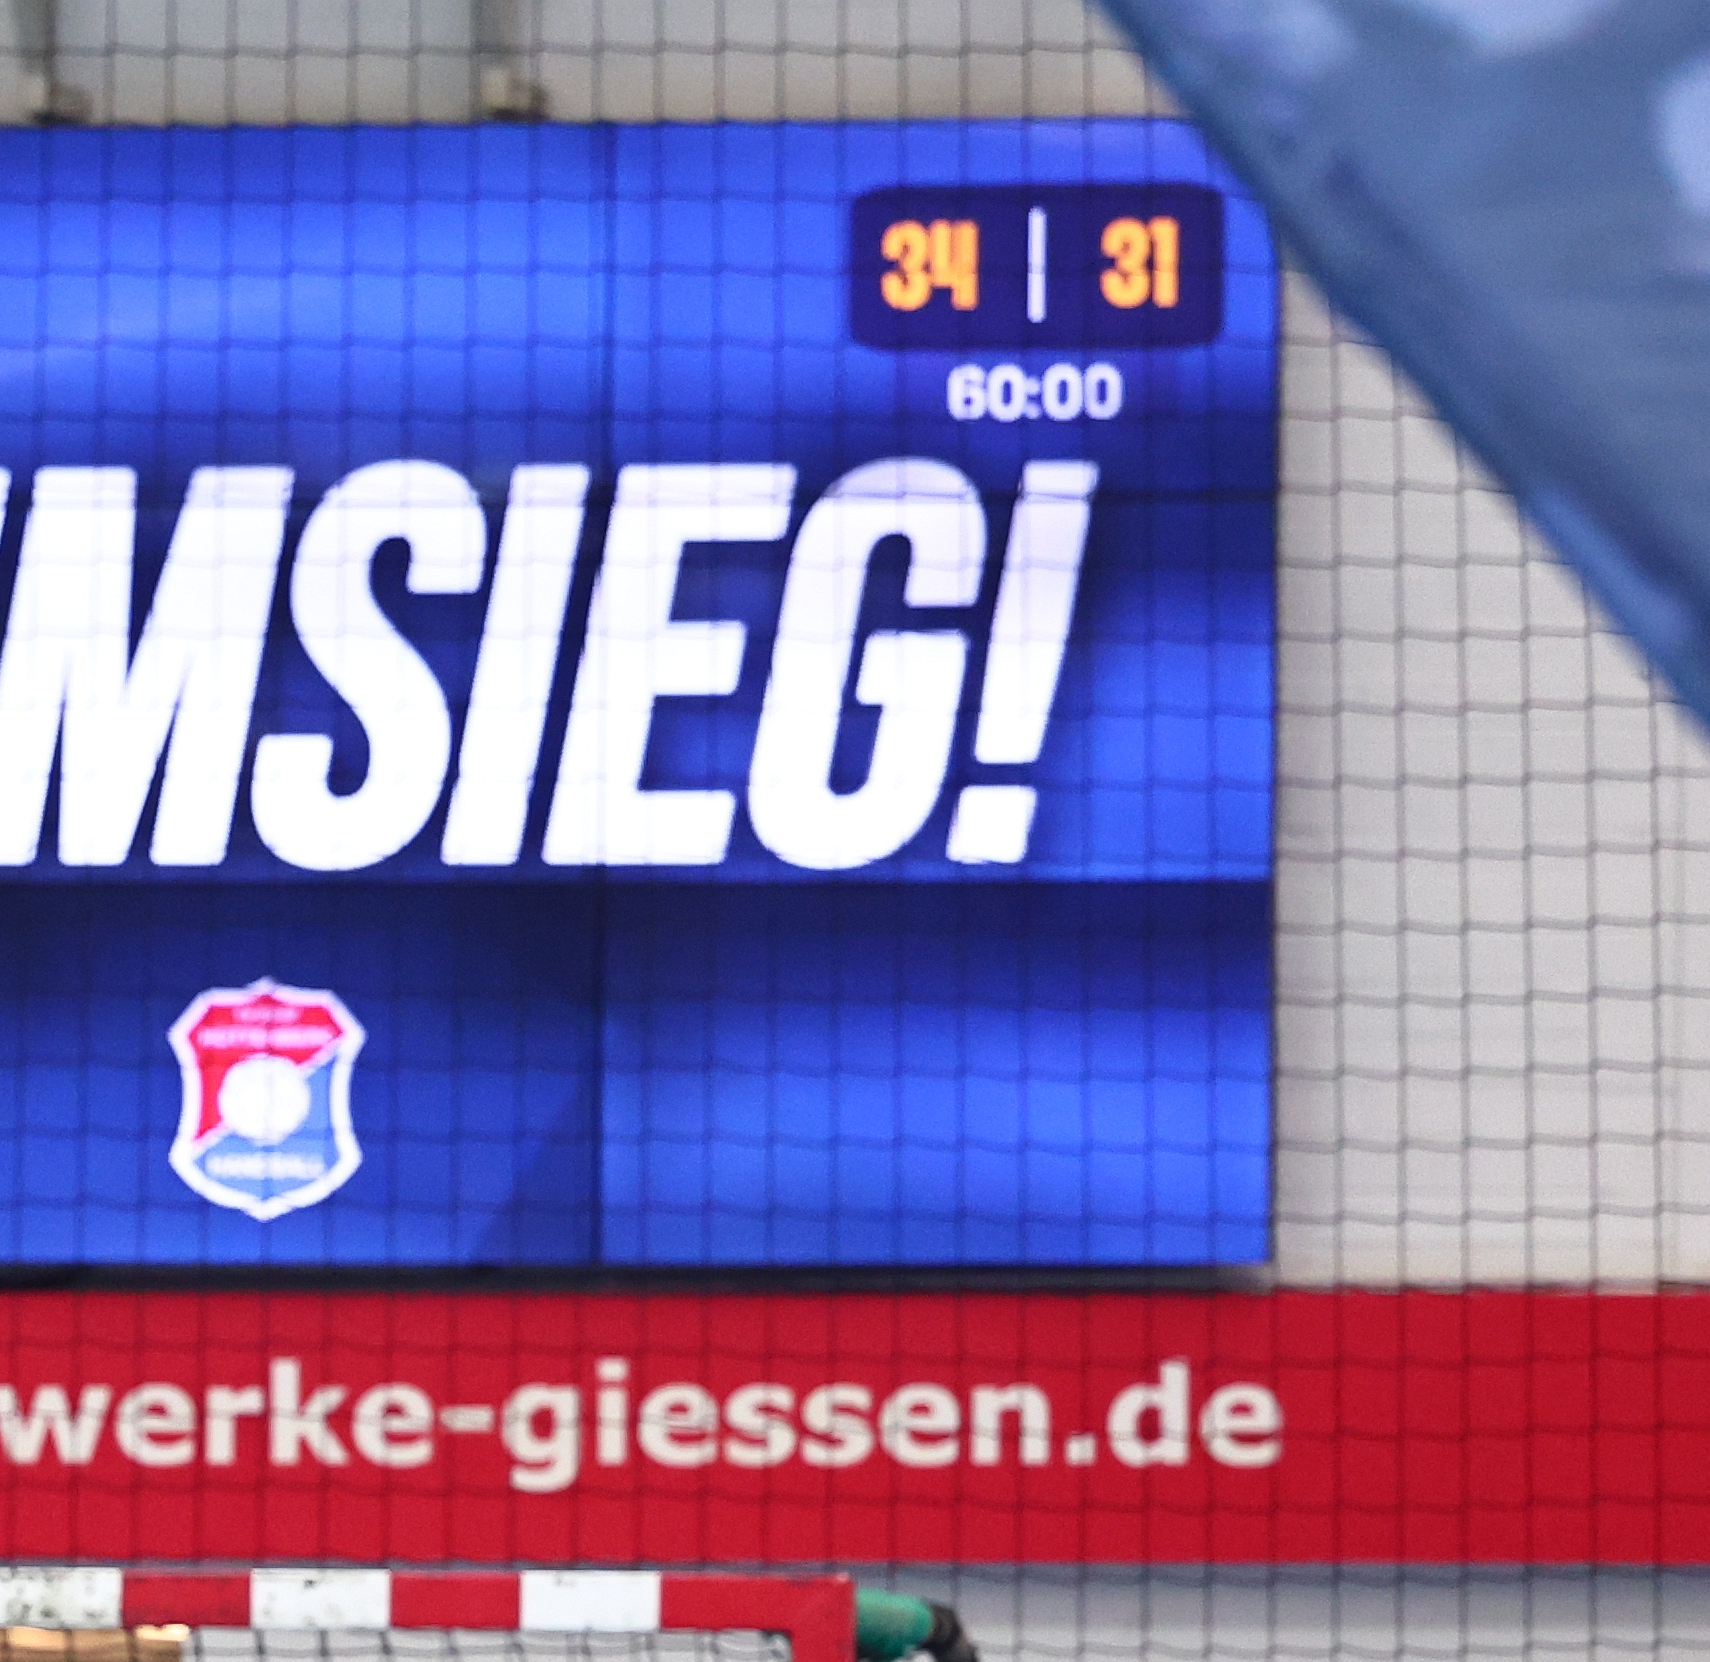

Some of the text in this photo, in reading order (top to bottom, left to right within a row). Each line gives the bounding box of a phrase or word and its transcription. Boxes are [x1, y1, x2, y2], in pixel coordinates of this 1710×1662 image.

[882, 216, 1179, 311] 34 31
[947, 362, 1123, 422] 60:00
